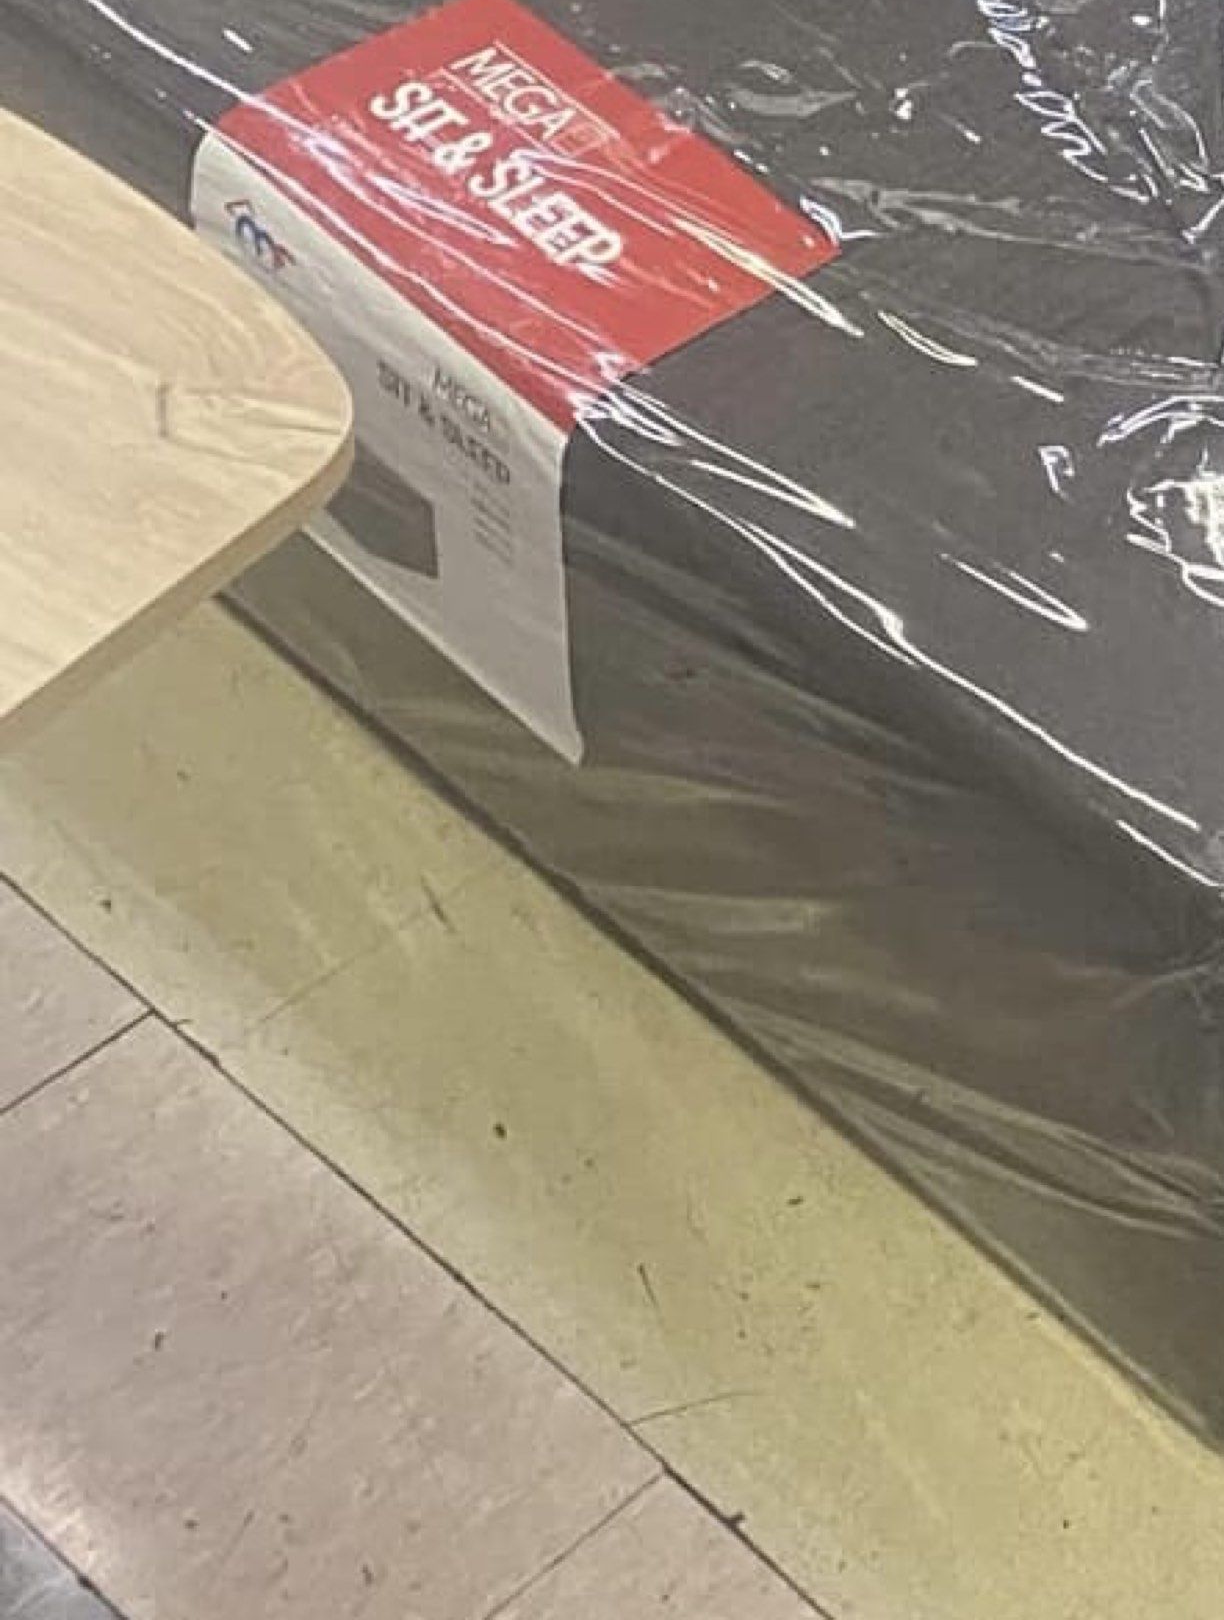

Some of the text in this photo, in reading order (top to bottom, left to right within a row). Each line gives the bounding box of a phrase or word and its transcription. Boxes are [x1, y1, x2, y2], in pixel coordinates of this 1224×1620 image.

[450, 47, 577, 141] MEGA
[369, 82, 470, 142] SIT
[431, 132, 493, 174] &
[468, 159, 624, 266] SLEEP
